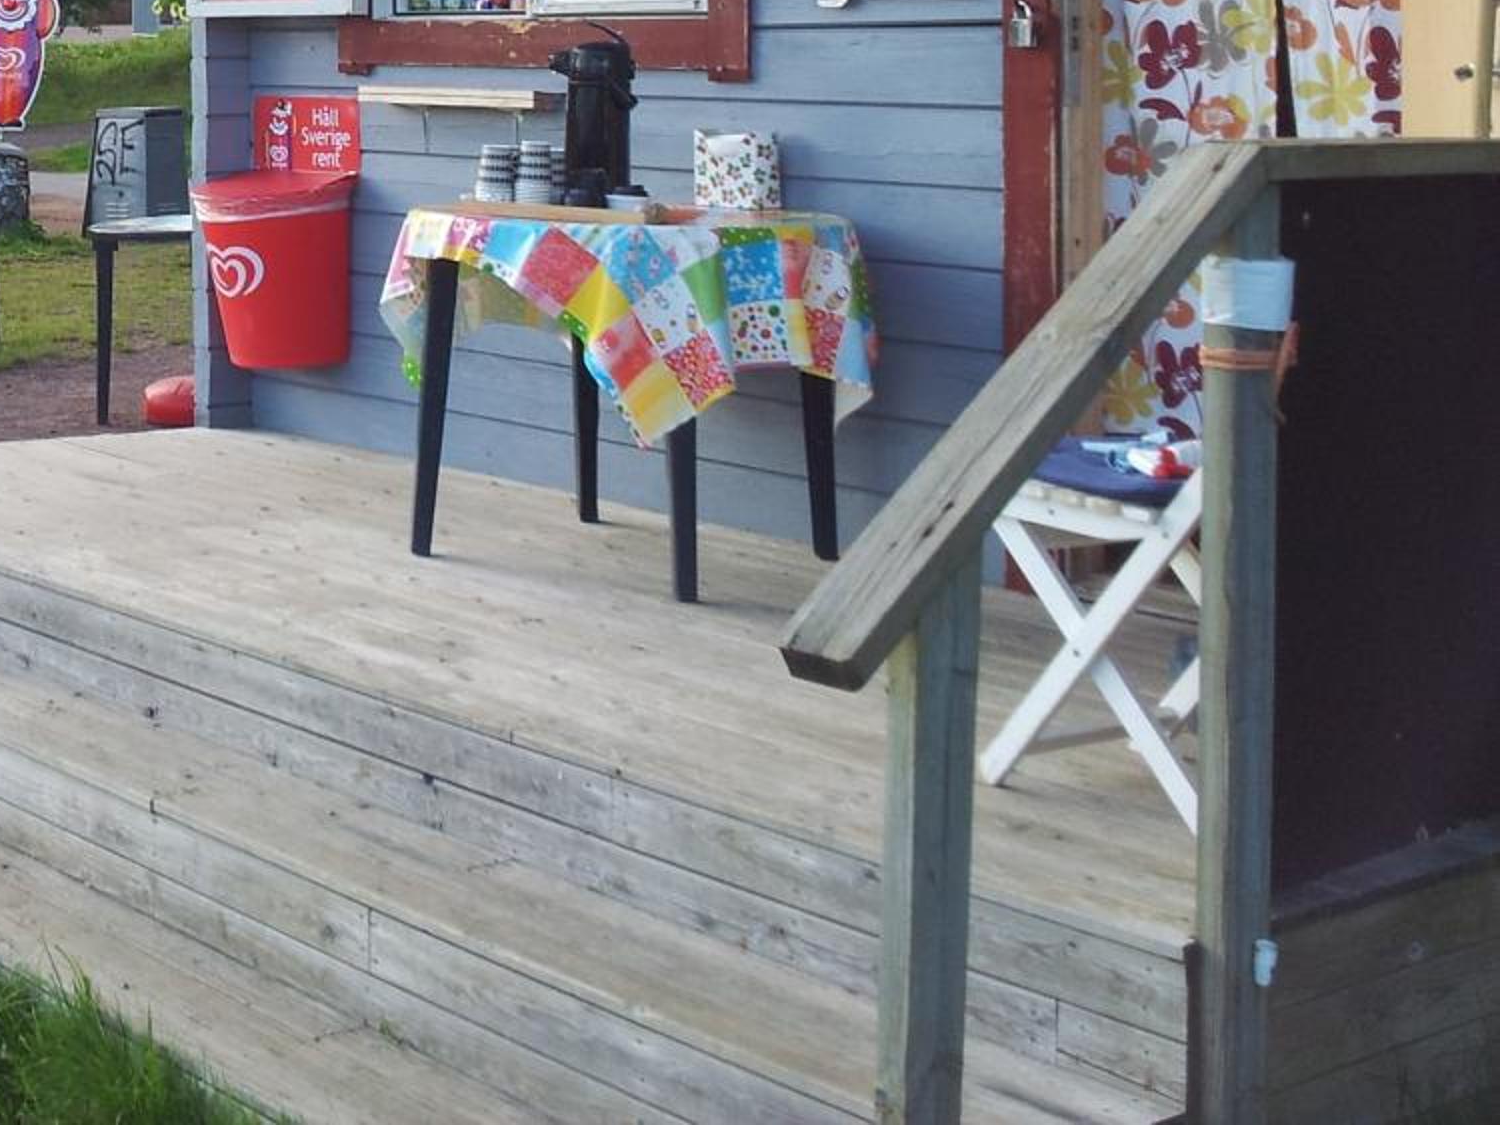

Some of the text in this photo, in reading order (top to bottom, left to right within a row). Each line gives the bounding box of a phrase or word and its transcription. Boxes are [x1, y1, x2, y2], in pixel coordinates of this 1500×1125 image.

[311, 105, 339, 127] Håll
[301, 126, 351, 150] Sverige
[311, 151, 341, 168] rent
